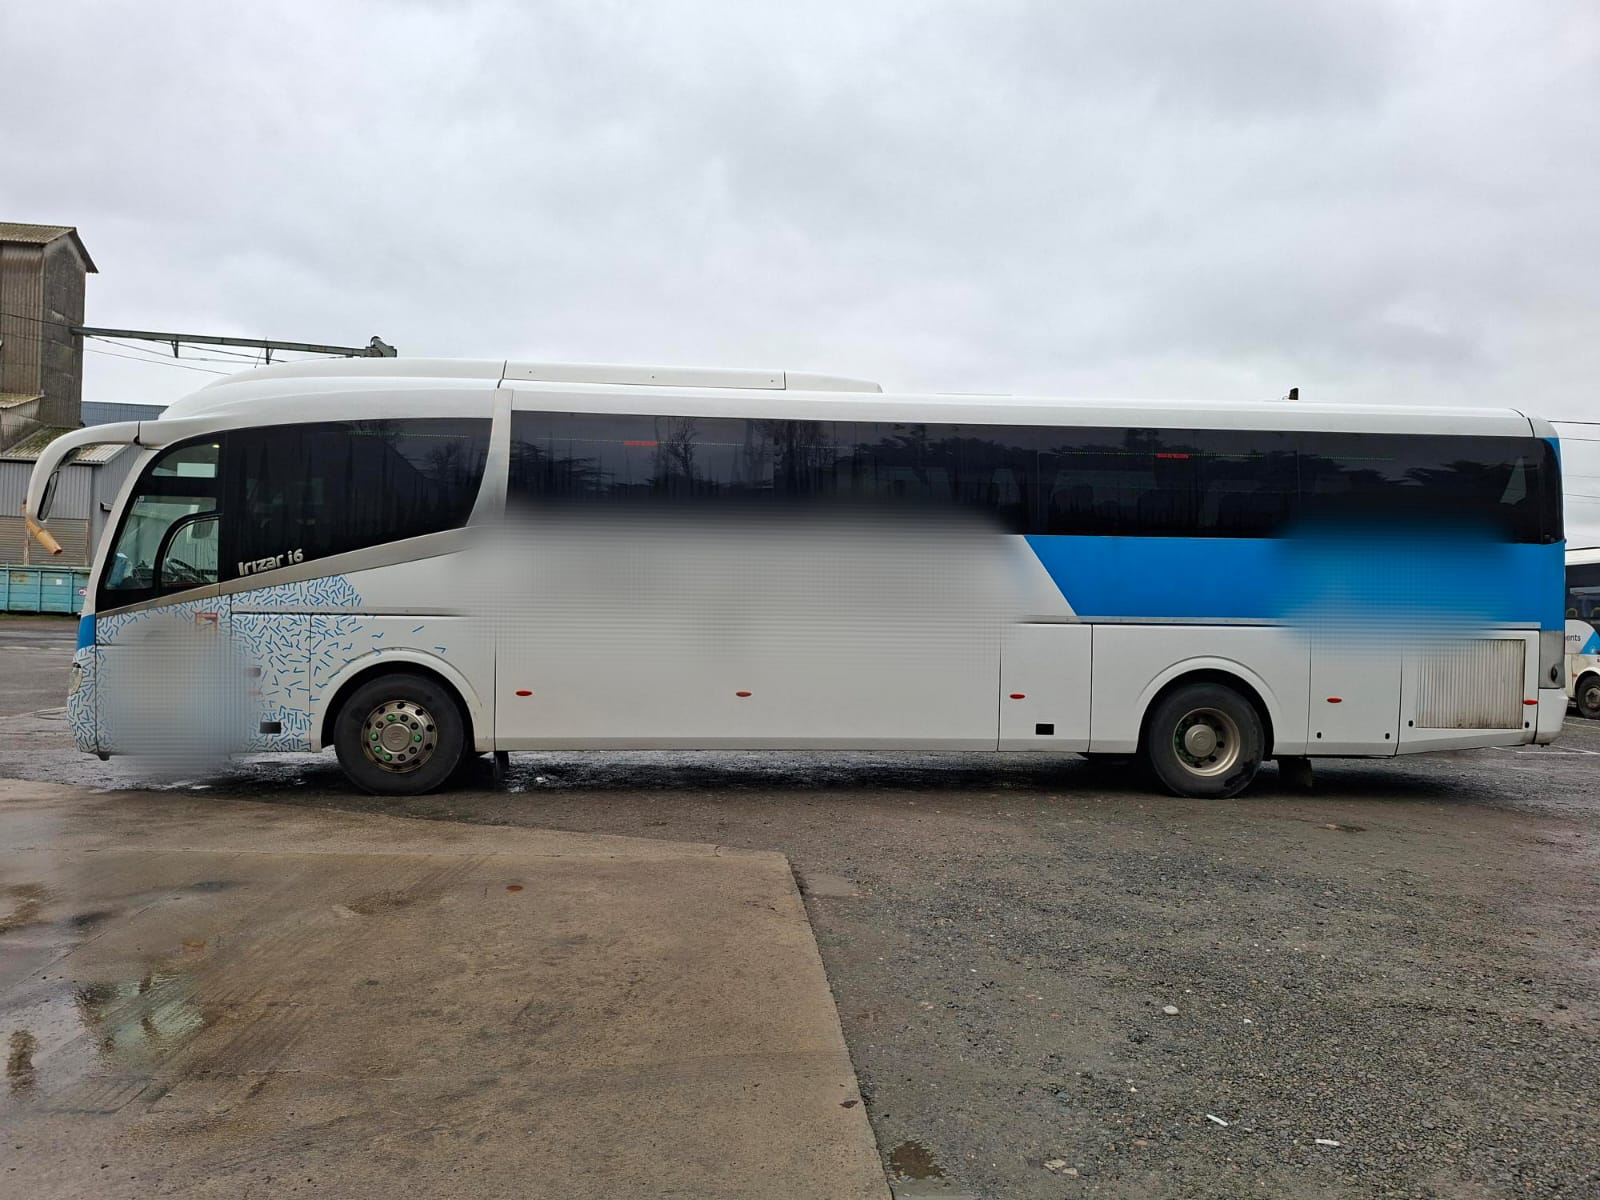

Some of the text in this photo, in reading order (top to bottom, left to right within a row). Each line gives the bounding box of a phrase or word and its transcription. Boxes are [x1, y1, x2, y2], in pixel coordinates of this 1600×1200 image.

[238, 548, 304, 576] Irizar i6
[1565, 633, 1581, 642] ents
